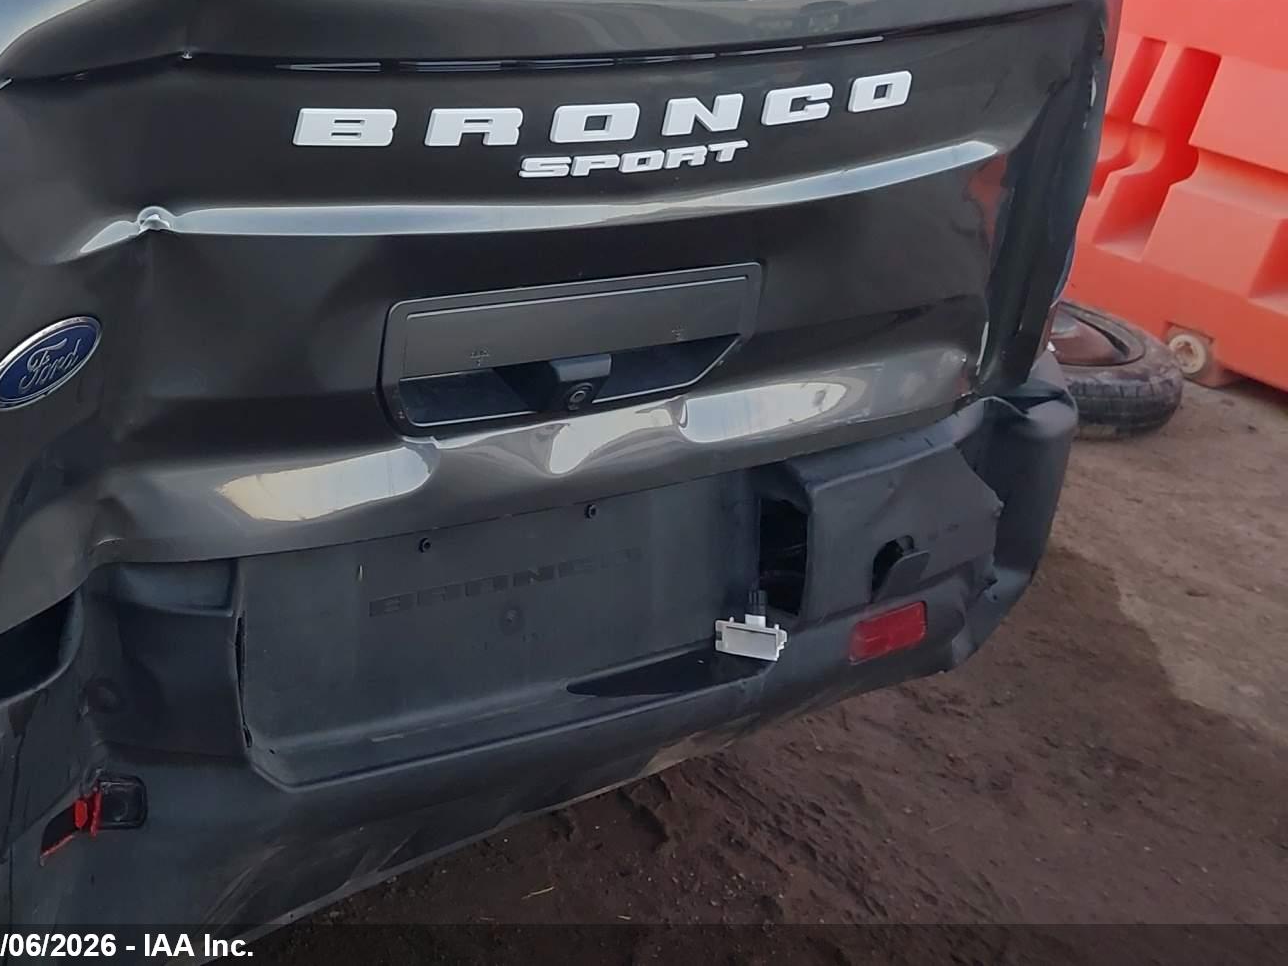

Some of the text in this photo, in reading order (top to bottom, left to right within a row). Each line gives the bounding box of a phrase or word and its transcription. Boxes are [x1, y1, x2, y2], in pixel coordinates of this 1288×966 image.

[291, 70, 913, 148] BRONCO
[518, 139, 749, 180] SPORT
[18, 337, 82, 394] Ford
